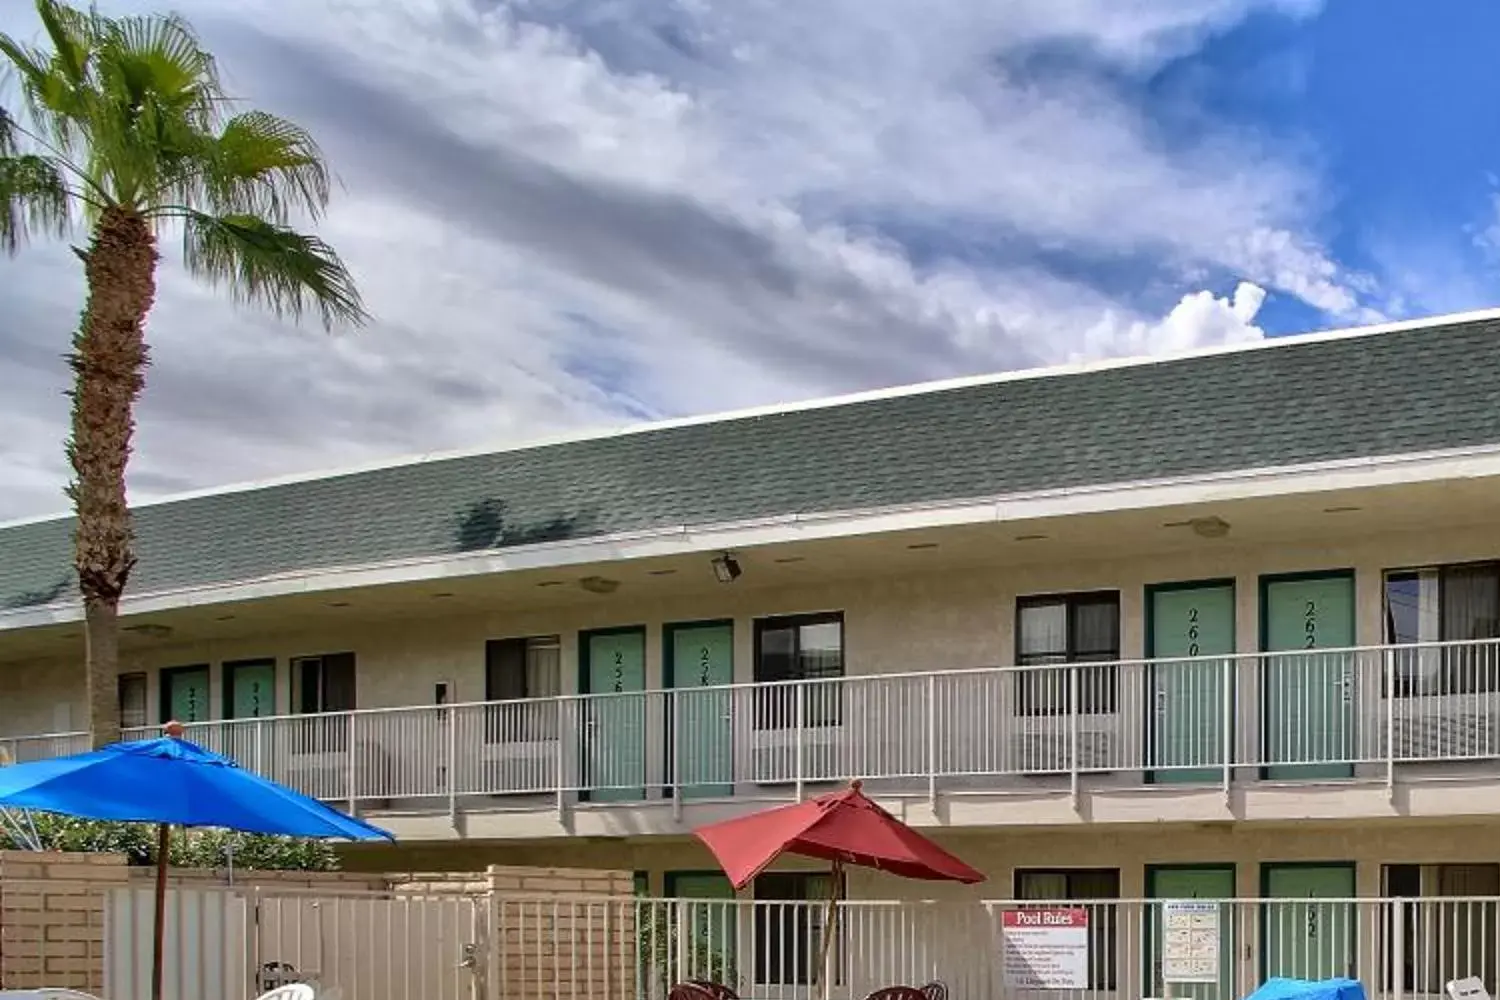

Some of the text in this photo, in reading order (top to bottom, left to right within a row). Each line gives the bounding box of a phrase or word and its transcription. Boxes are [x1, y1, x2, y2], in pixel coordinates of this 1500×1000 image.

[1189, 607, 1199, 657] 260
[1305, 601, 1316, 650] 262
[1017, 911, 1073, 925] Pool Rules
